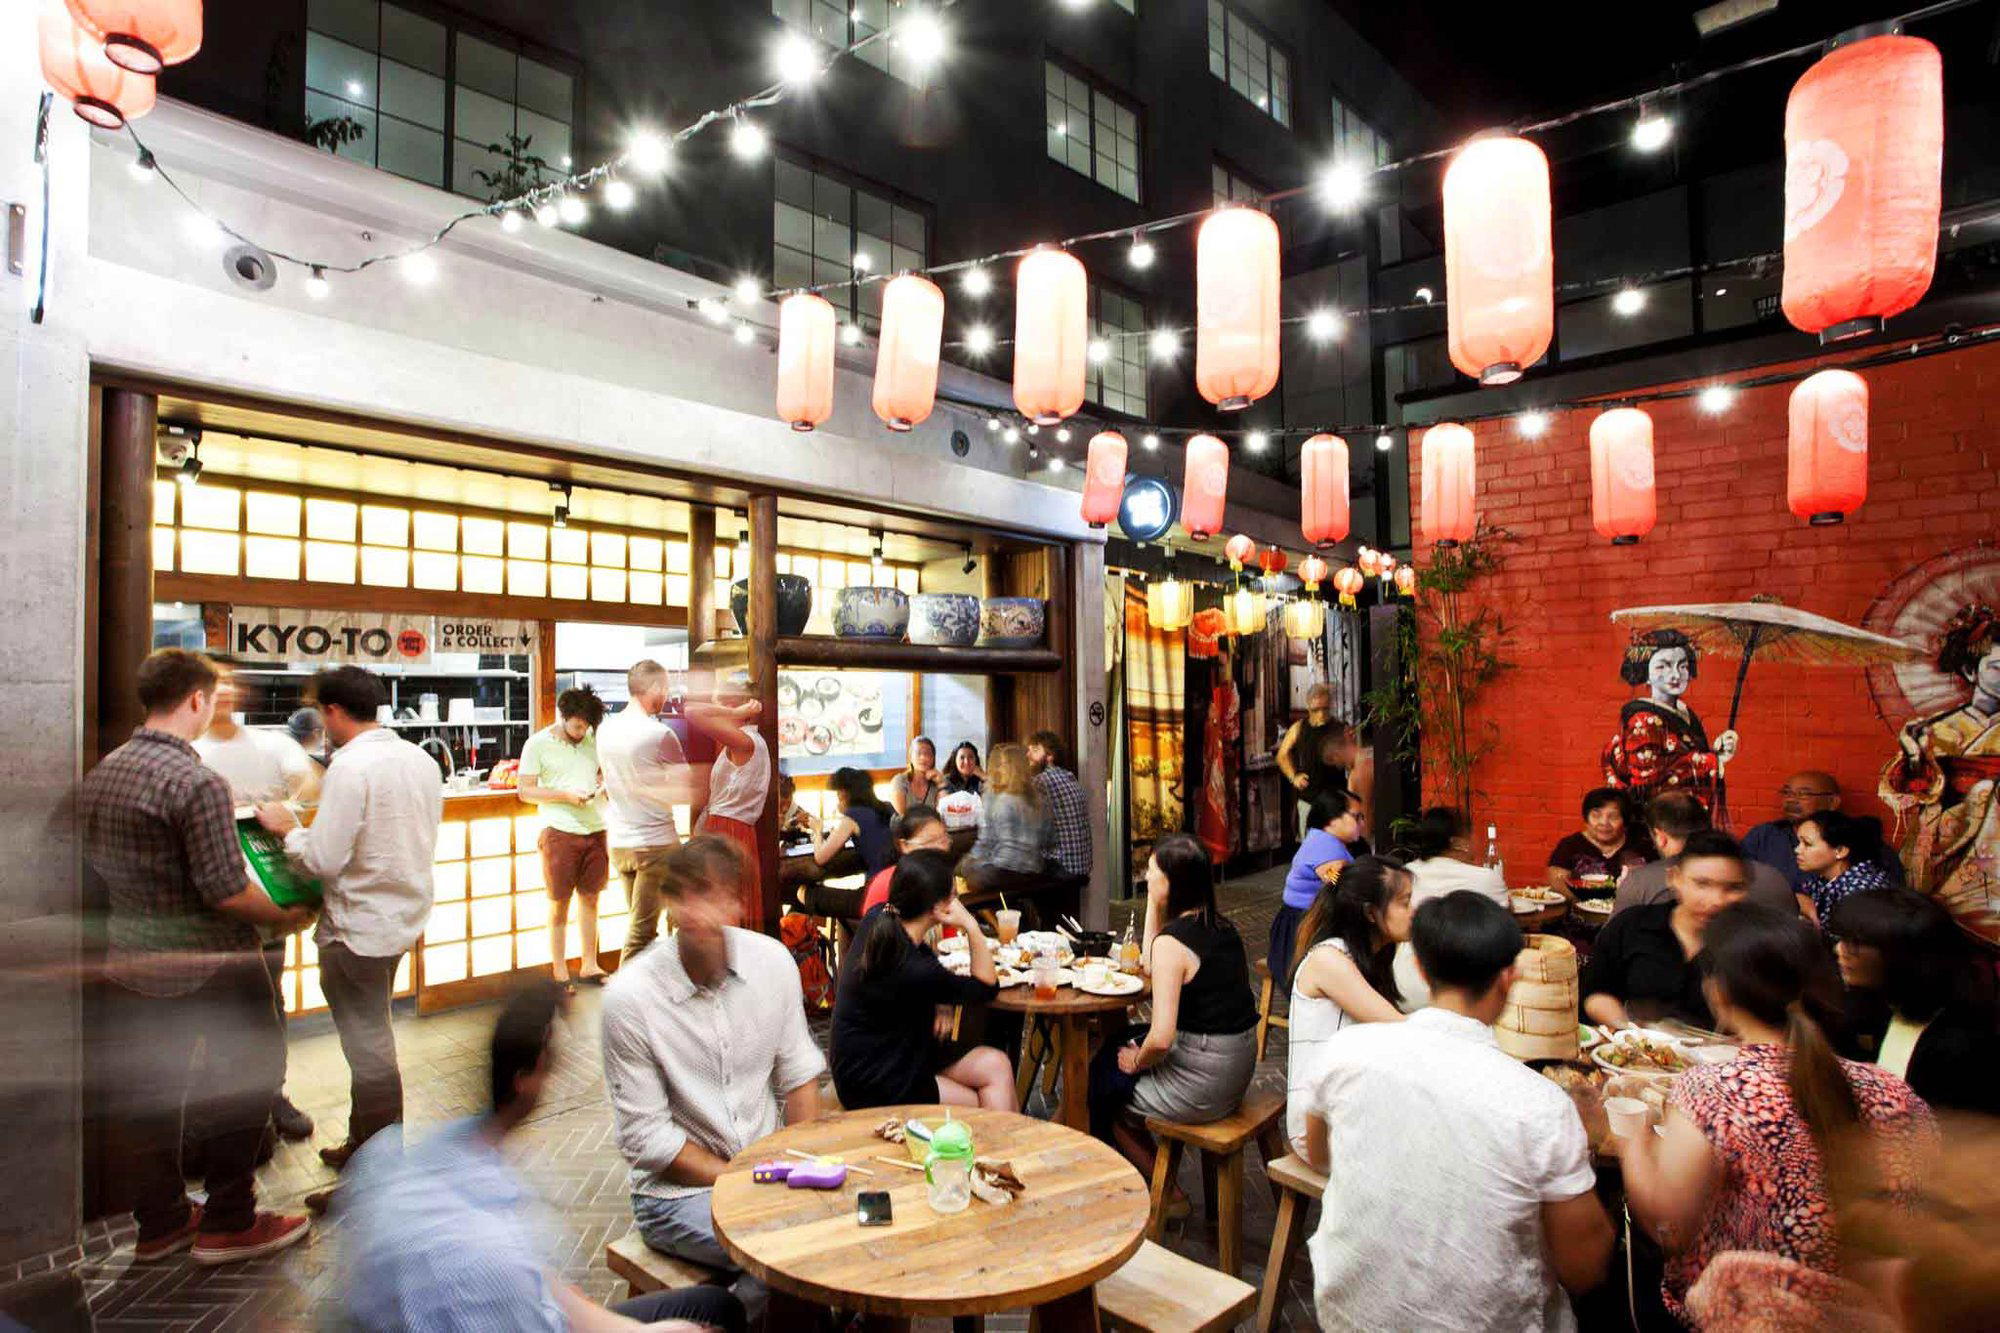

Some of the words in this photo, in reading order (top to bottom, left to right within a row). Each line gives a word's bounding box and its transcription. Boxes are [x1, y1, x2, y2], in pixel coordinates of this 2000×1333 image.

[443, 624, 492, 636] ORDER
[238, 623, 392, 656] KYO-TO
[443, 636, 452, 647] &
[457, 635, 515, 647] COLLECT
